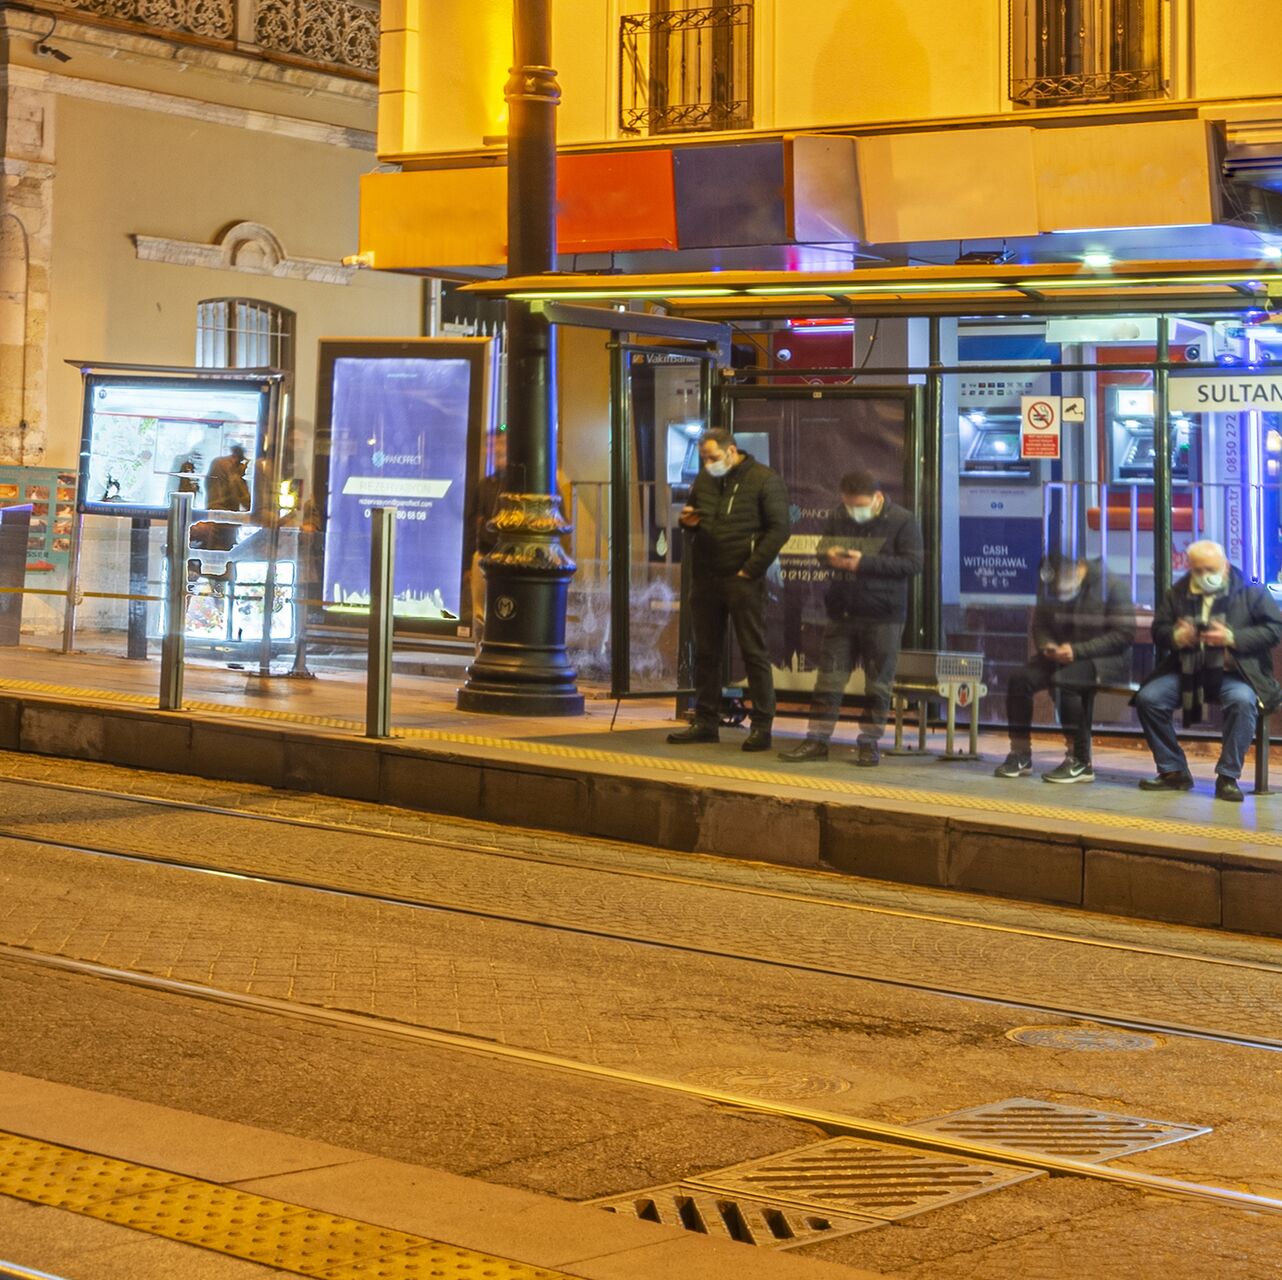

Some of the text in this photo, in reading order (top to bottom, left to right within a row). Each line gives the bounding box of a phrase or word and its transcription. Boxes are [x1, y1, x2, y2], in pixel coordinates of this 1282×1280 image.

[1226, 435, 1238, 474] 0850
[982, 544, 1009, 556] CASH
[963, 556, 1028, 569] WITHDRAWAL
